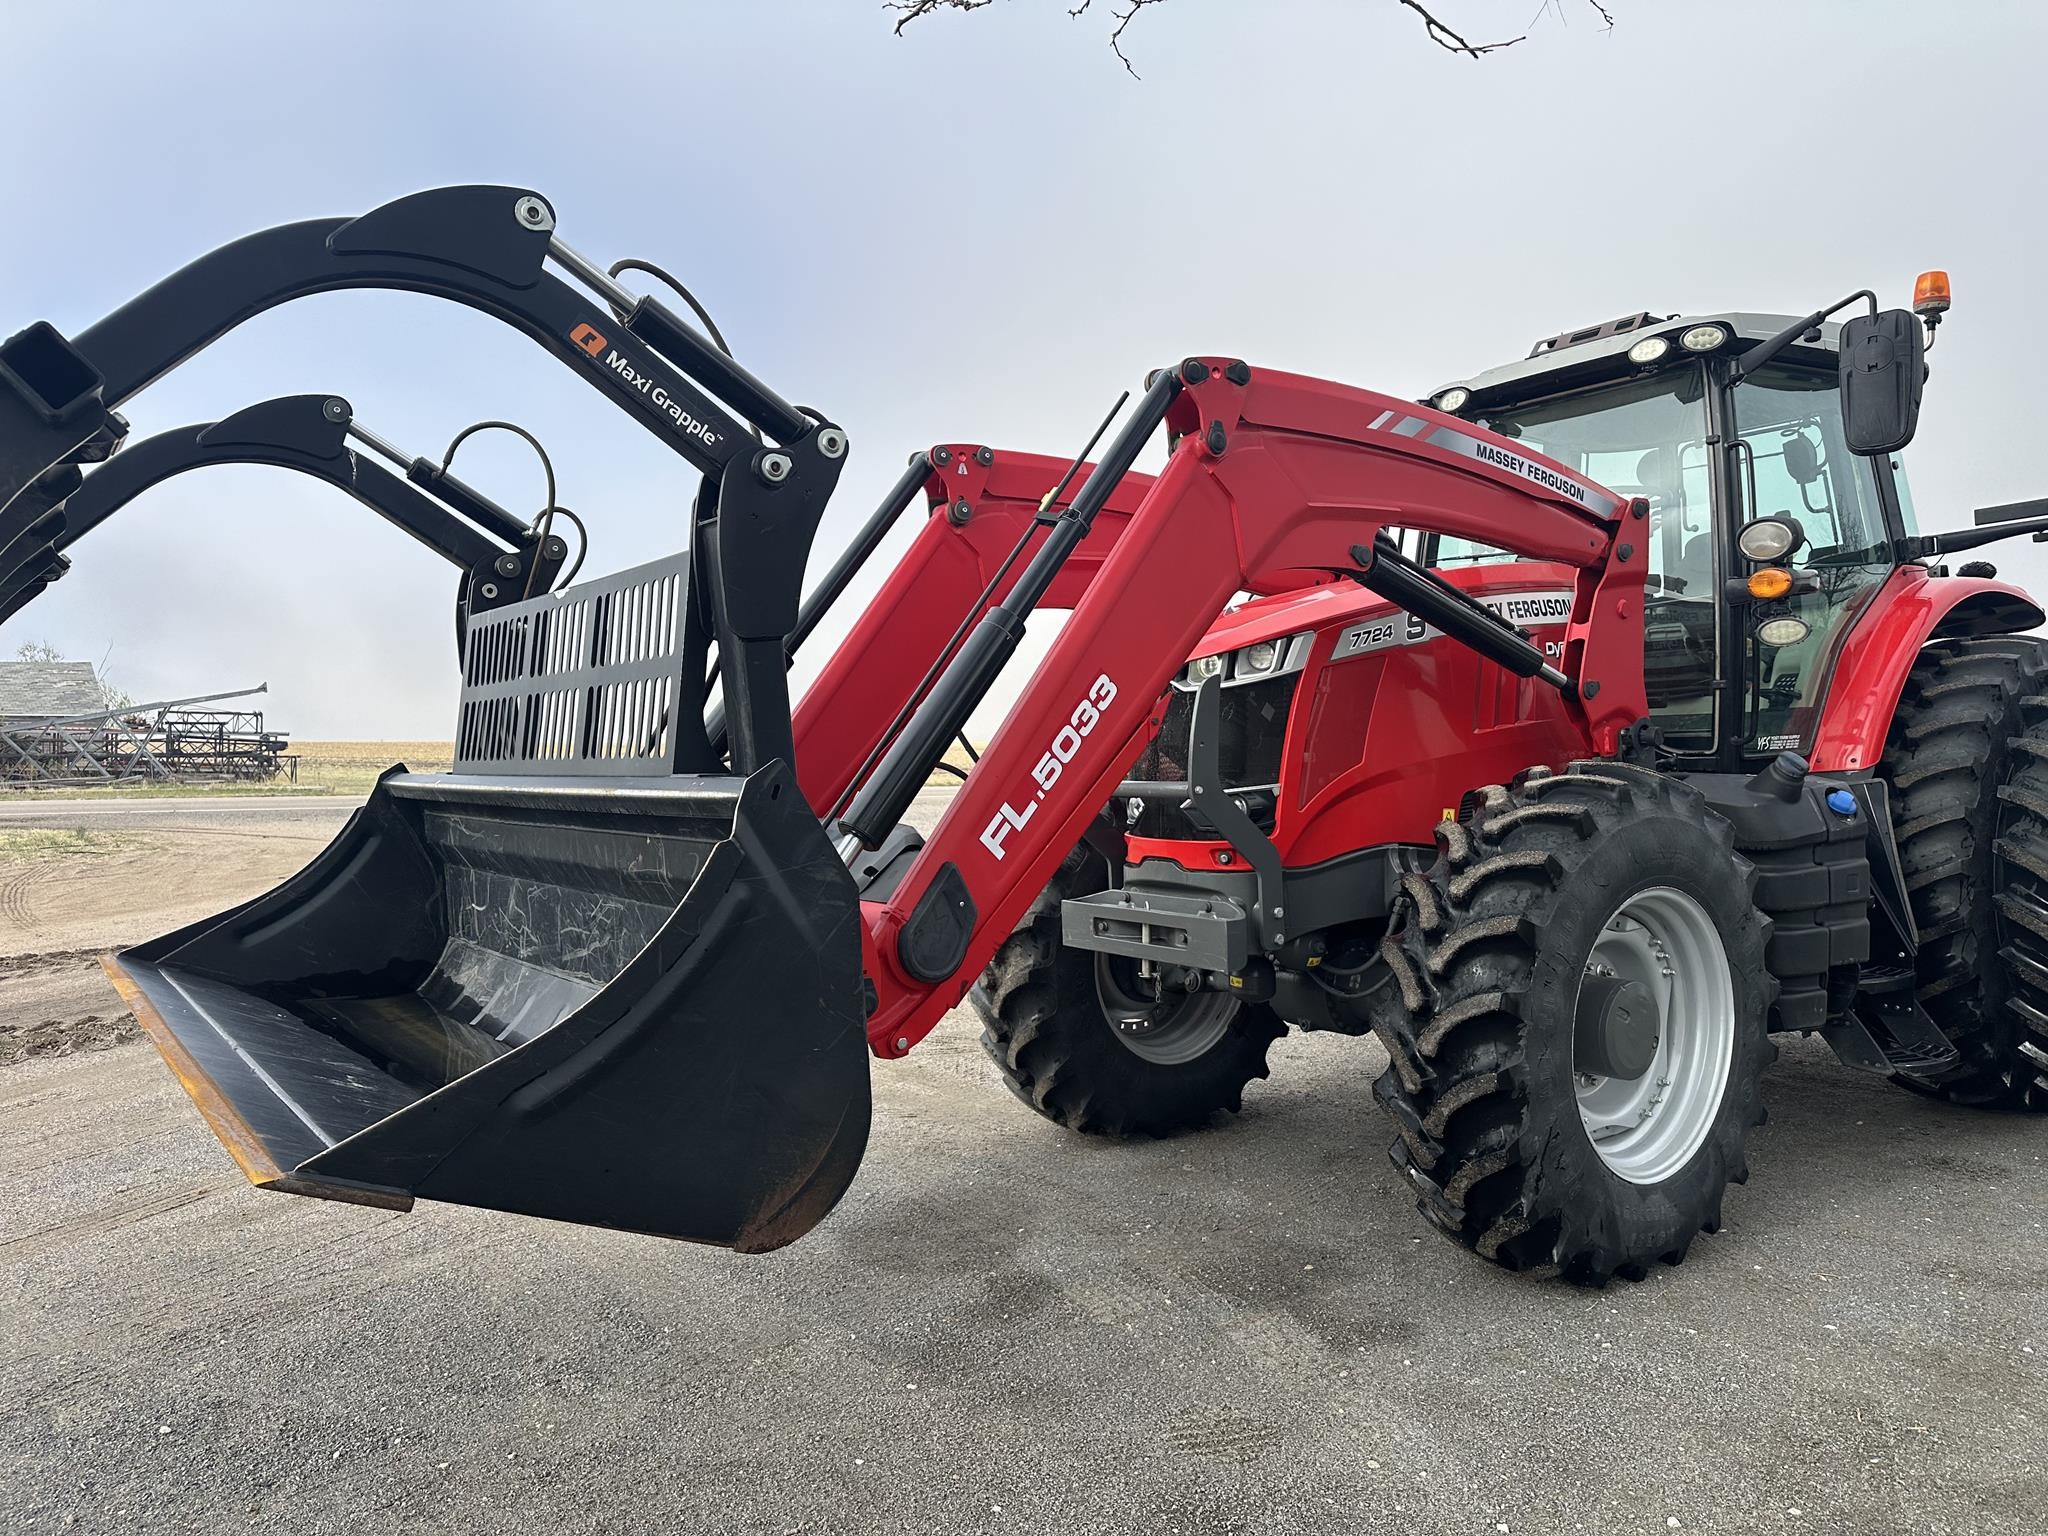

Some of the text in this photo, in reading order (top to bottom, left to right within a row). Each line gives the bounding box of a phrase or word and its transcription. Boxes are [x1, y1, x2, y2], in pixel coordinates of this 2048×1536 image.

[605, 350, 653, 394] Maxi
[1476, 443, 1585, 501] MASSEY FERGUSON
[1350, 612, 1427, 649] 7724 S
[1506, 599, 1571, 619] FERGUSON
[979, 673, 1118, 861] FL.5033
